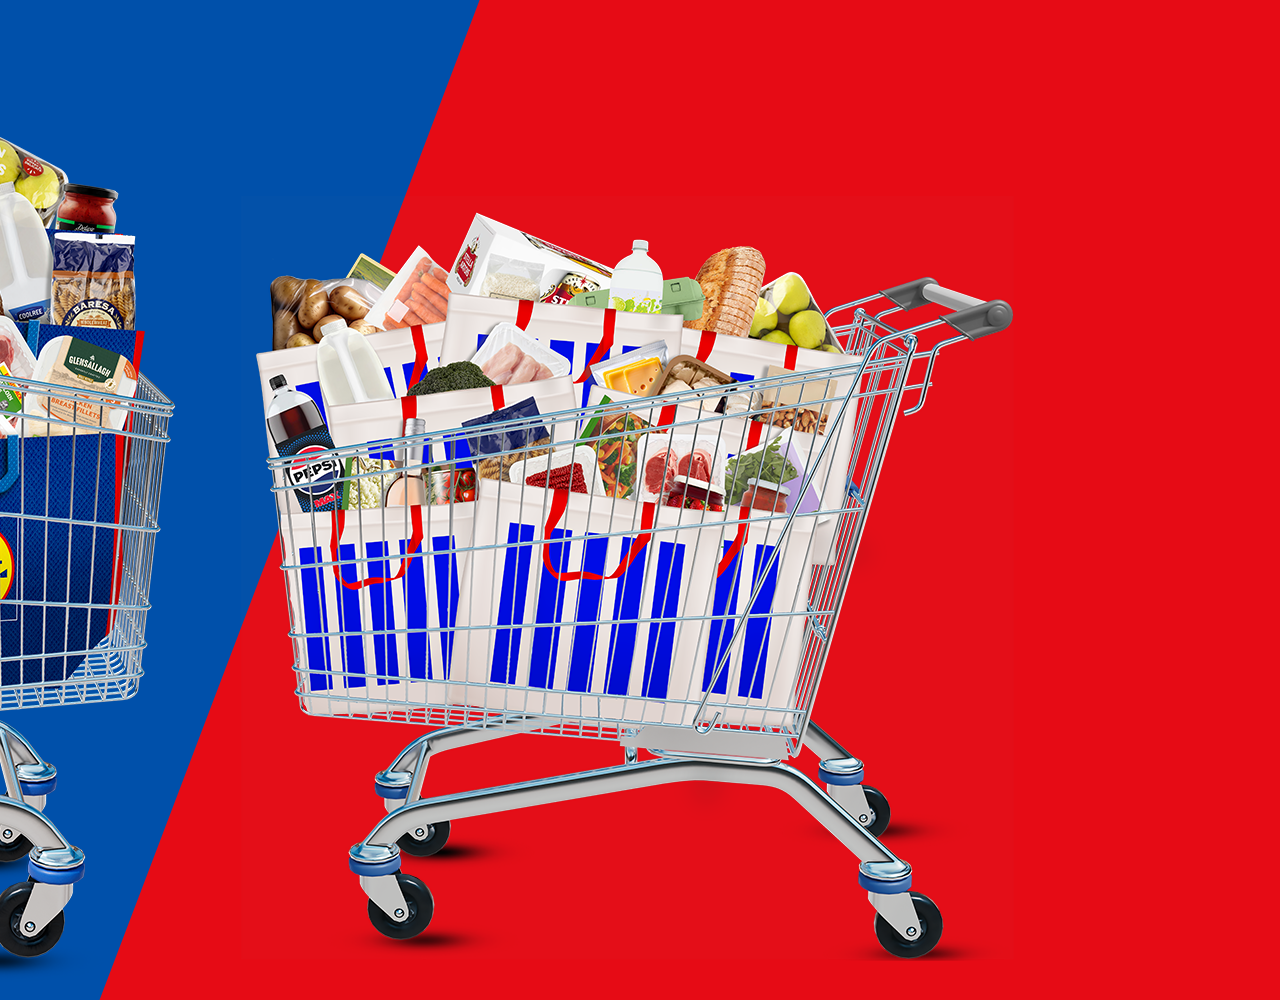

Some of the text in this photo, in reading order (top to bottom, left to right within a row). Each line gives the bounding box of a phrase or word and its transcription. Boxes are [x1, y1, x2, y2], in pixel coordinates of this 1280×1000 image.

[18, 308, 44, 320] COOLREE
[72, 300, 115, 316] BARESA
[68, 355, 112, 378] GLENSALLAGH
[76, 406, 100, 420] FILLETS
[314, 490, 341, 508] MAX
